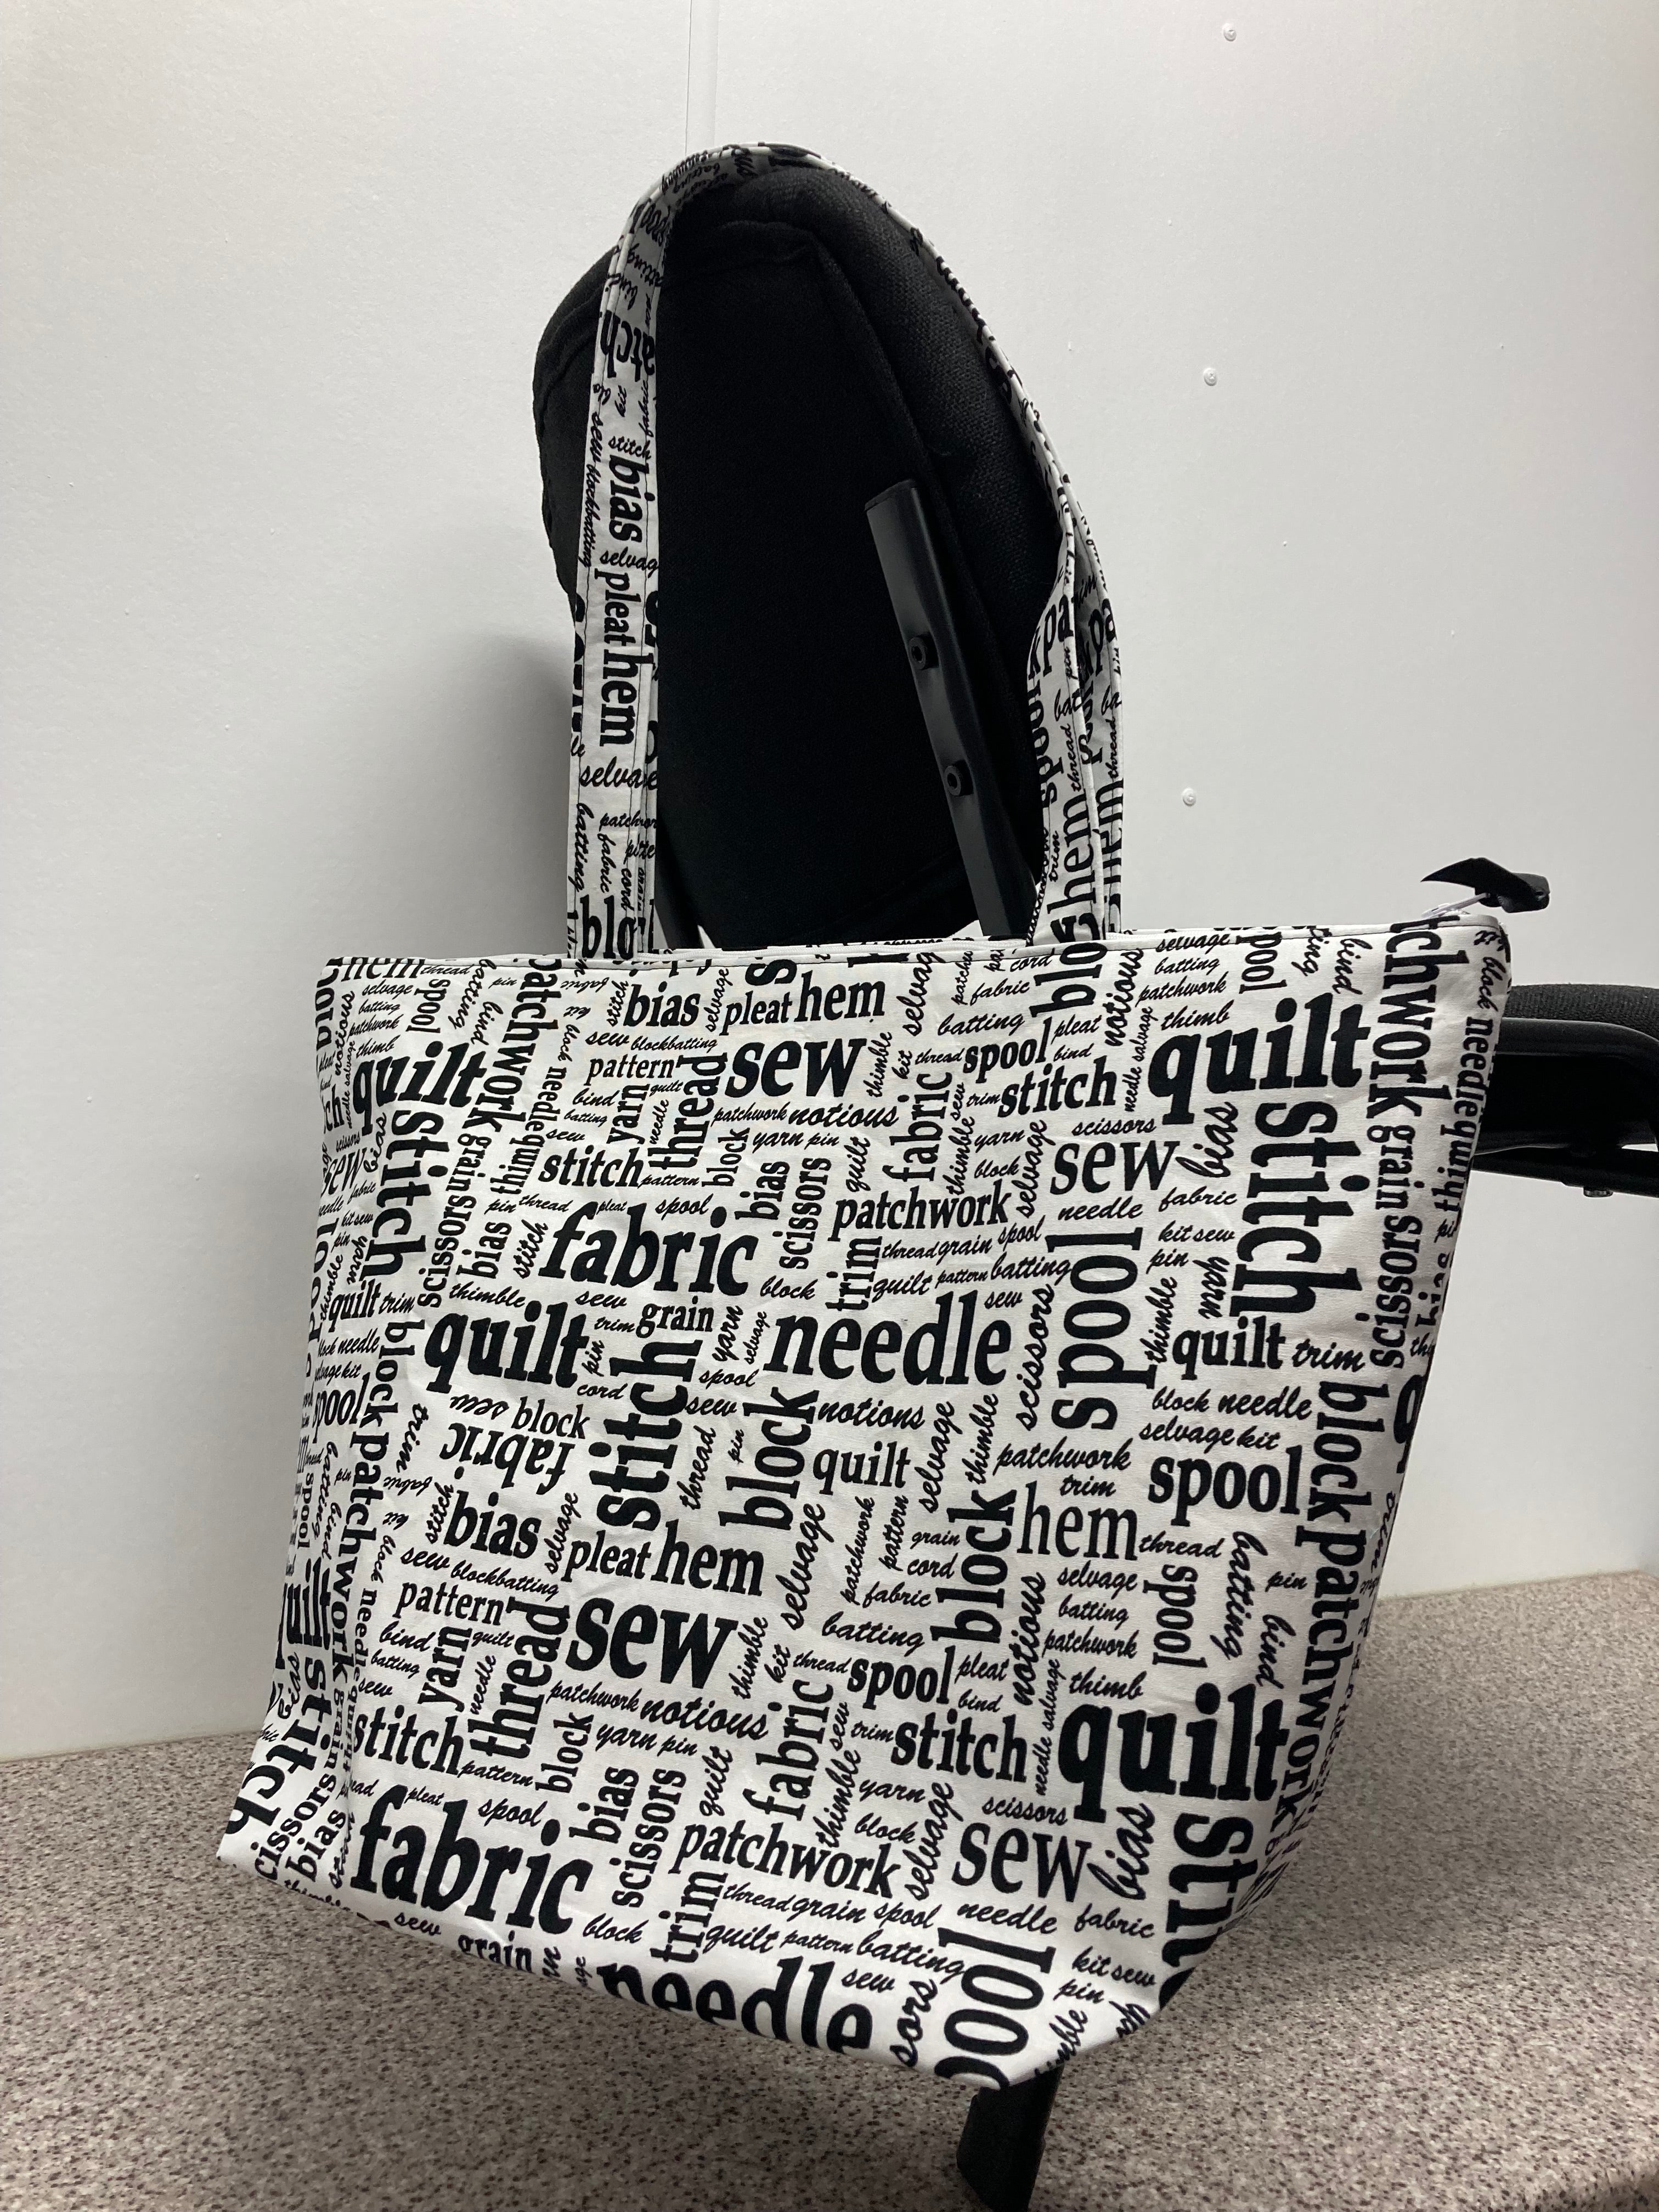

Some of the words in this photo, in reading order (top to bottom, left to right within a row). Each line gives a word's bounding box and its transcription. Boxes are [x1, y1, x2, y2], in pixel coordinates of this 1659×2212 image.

[608, 435, 652, 460] stitch
[608, 453, 654, 543] bias
[594, 568, 641, 646] pleat
[600, 648, 655, 747] hem
[1047, 793, 1097, 914] hem
[362, 979, 413, 1000] selvage
[488, 978, 517, 989] pin
[794, 970, 885, 1023] hem
[1154, 957, 1220, 975] batting
[347, 1014, 403, 1040] patchwork
[358, 999, 400, 1015] batting
[405, 979, 450, 1033] spool
[471, 1001, 503, 1045] bind
[623, 981, 701, 1027] bias
[719, 990, 793, 1036] pleat
[585, 1054, 674, 1086] pattern
[725, 1038, 867, 1098] sew
[963, 1014, 1053, 1084] spool
[1148, 992, 1371, 1125] quilt
[353, 1039, 487, 1136] quilt
[646, 1052, 728, 1170] thread
[710, 1102, 791, 1127] patchwork
[997, 1056, 1117, 1118] stitch
[752, 1132, 804, 1154] yarn
[804, 1132, 839, 1147] pin
[882, 1072, 952, 1182] fabric
[1175, 1102, 1238, 1178] bias
[356, 1110, 452, 1282] stitch
[538, 1144, 646, 1188] stitch
[734, 1161, 790, 1220] bias
[1011, 1120, 1056, 1218] selvage
[1050, 1140, 1180, 1195] sew
[1158, 1186, 1237, 1212] fabric
[1367, 1125, 1425, 1210] grain
[772, 1158, 832, 1269] scissors
[827, 1178, 1012, 1242] patchwork
[1058, 1195, 1143, 1221] needle
[1158, 1220, 1193, 1242] kit
[1193, 1229, 1235, 1242] sew
[1229, 1101, 1370, 1320] stitch
[417, 1195, 479, 1308] scissors
[538, 1197, 759, 1296] fabric
[825, 1236, 882, 1311] trim
[935, 1269, 988, 1289] pattern
[990, 1252, 1072, 1286] batting
[328, 1278, 381, 1333] quilt
[379, 1292, 415, 1314] trim
[594, 1317, 635, 1333] trim
[636, 1295, 714, 1338] grain
[1139, 1277, 1177, 1363] thimble
[1355, 1215, 1425, 1369] scissors
[337, 1328, 380, 1354] needle
[424, 1300, 590, 1393] quilt
[763, 1287, 1015, 1386] needle
[1016, 1284, 1054, 1431] scissors
[1043, 1227, 1158, 1430] spool
[1172, 1315, 1286, 1381] quilt
[1291, 1338, 1365, 1372] trim
[362, 1319, 425, 1427] block
[1152, 1386, 1211, 1413] block
[1218, 1386, 1312, 1420] needle
[449, 1394, 509, 1420] sew
[511, 1396, 590, 1439] block
[586, 1339, 705, 1531] stitch
[818, 1398, 925, 1430] notions
[962, 1393, 998, 1485] thimble
[1139, 1415, 1235, 1454] selvage
[1237, 1425, 1280, 1450] kit
[439, 1423, 575, 1495] fabric
[677, 1425, 716, 1510] thread
[718, 1387, 820, 1531] block
[727, 1429, 744, 1464] pin
[813, 1441, 911, 1496] quilt
[915, 1401, 963, 1514] selvage
[992, 1436, 1133, 1476] patchwork
[1307, 1381, 1390, 1523] block
[1148, 1444, 1302, 1527] spool
[443, 1490, 541, 1559] bias
[840, 1496, 875, 1605] patchwork
[910, 1531, 960, 1549] grain
[1017, 1477, 1138, 1561] hem
[1138, 1531, 1225, 1558] thread
[331, 1431, 392, 1683] patchwork
[561, 1530, 651, 1583] pleat
[651, 1519, 764, 1596] hem
[775, 1504, 834, 1630] selvage
[907, 1553, 958, 1579] cord
[930, 1489, 1018, 1644] block
[1057, 1560, 1138, 1600] selvage
[392, 1582, 504, 1626] pattern
[1059, 1594, 1129, 1630] batting
[1142, 1564, 1207, 1668] spool
[1210, 1531, 1268, 1660] batting
[565, 1598, 742, 1689] sew
[729, 1617, 768, 1700] thimble
[793, 1650, 852, 1673] thread
[822, 1611, 925, 1657] batting
[1041, 1626, 1139, 1659] patchwork
[417, 1626, 472, 1712] yarn
[467, 1596, 570, 1759] thread
[546, 1680, 642, 1712] patchwork
[847, 1645, 956, 1710] spool
[958, 1689, 1003, 1712] bind
[1272, 1525, 1367, 1836] patchwork
[354, 1705, 464, 1776] stitch
[458, 1760, 534, 1787] pattern
[535, 1712, 594, 1793] block
[742, 1679, 833, 1821] fabric
[890, 1708, 1027, 1783] stitch
[1032, 1737, 1052, 1796] needle
[1058, 1680, 1290, 1824] quilt
[568, 1767, 639, 1844] bias
[812, 1750, 861, 1848] thimble
[981, 1797, 1068, 1826] scissors
[285, 1809, 346, 1882] bias
[347, 1785, 593, 1937] fabric
[606, 1767, 686, 1908] scissors
[668, 1820, 901, 1901] patchwork
[902, 1782, 963, 1901] selvage
[951, 1822, 1092, 1903] sew
[1086, 1803, 1155, 1900] bias
[394, 1912, 441, 1938] sew
[583, 1913, 649, 1944] block
[650, 1871, 728, 1963] trim
[957, 1904, 1057, 1934] needle
[1074, 1903, 1154, 1938] fabric
[856, 1929, 969, 1984] batting
[1072, 1946, 1111, 1977] kit
[1111, 1965, 1155, 1988] sew
[1053, 1979, 1104, 2004] pin
